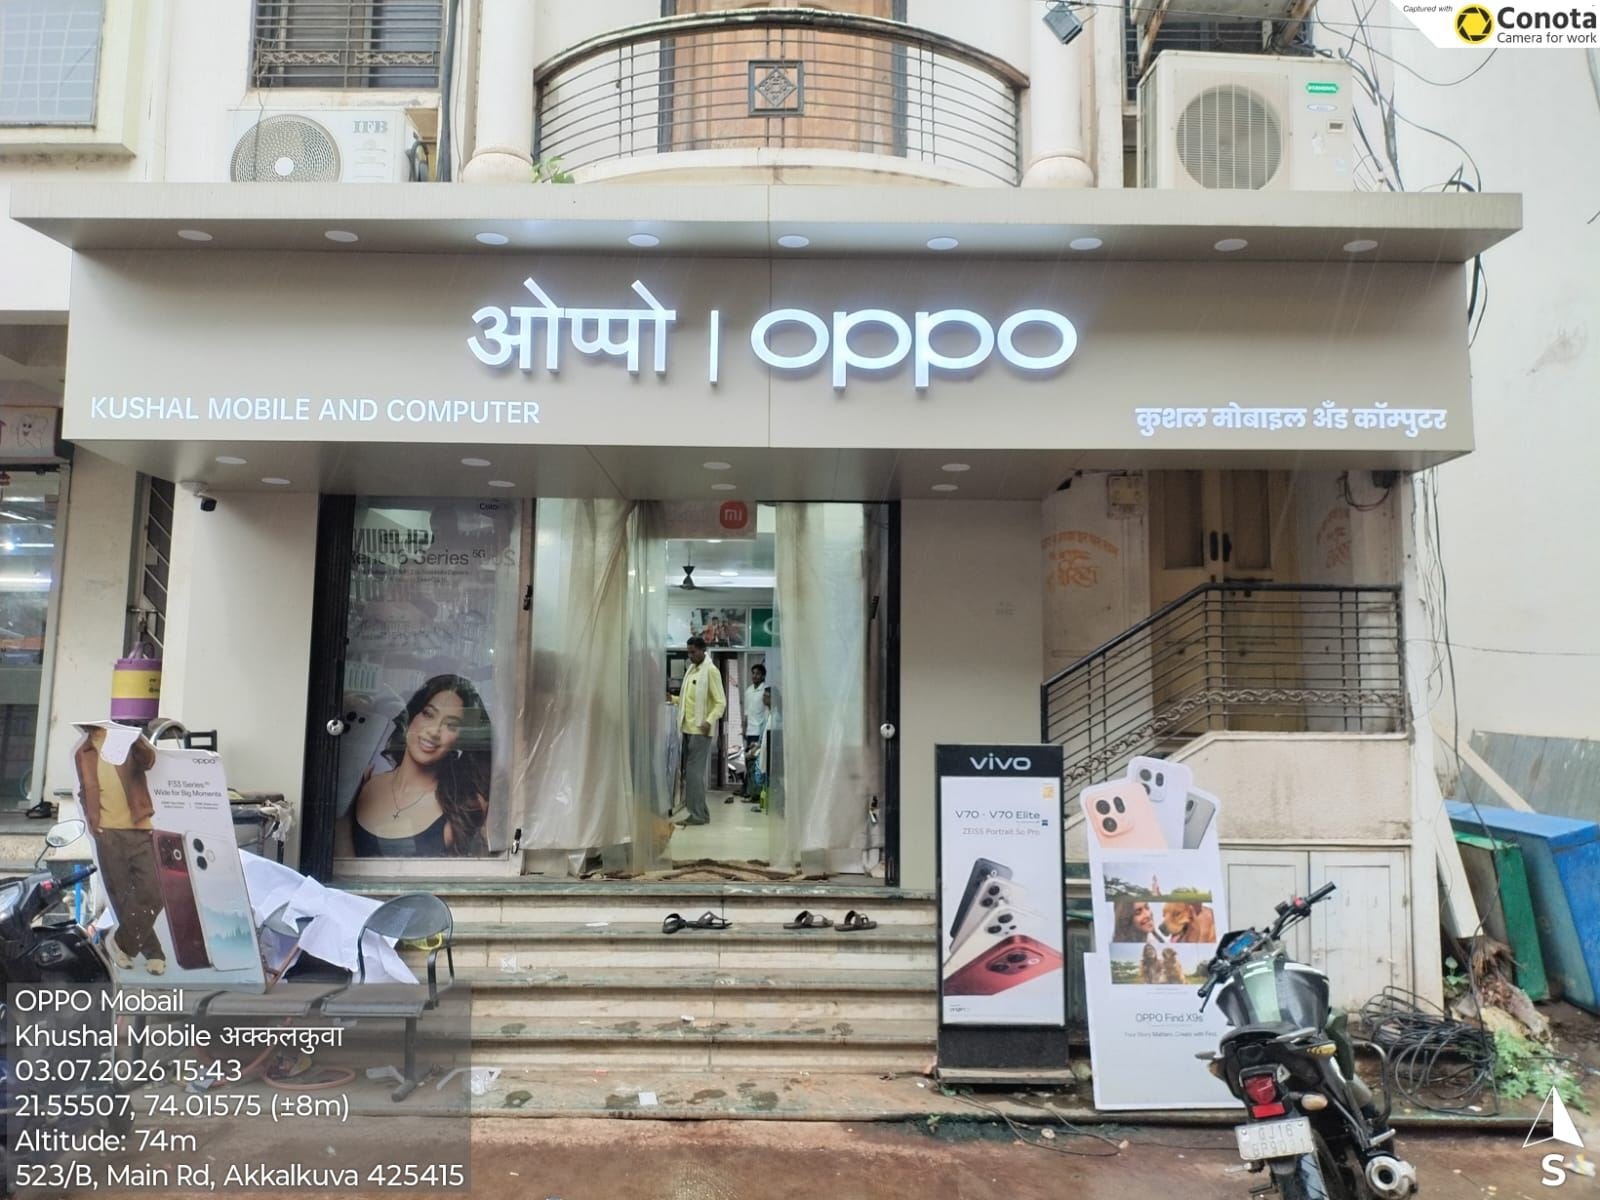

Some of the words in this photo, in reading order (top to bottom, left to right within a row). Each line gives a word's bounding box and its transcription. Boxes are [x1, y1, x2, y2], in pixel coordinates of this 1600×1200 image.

[353, 120, 388, 133] IFB
[466, 277, 677, 373] ओप्पो
[90, 396, 199, 421] KUSHAL
[207, 397, 310, 422] MOBILE
[318, 399, 378, 422] AND
[386, 400, 540, 424] COMPUTER
[1135, 407, 1207, 436] कुशल
[1211, 402, 1307, 431] मोबाइल
[413, 549, 469, 565] Series
[969, 753, 1031, 770] vivo
[955, 810, 980, 819] V70
[989, 810, 1014, 819] V70
[1015, 810, 1041, 820] Elite
[1135, 1012, 1164, 1022] OPPO
[1165, 1012, 1185, 1022] Find
